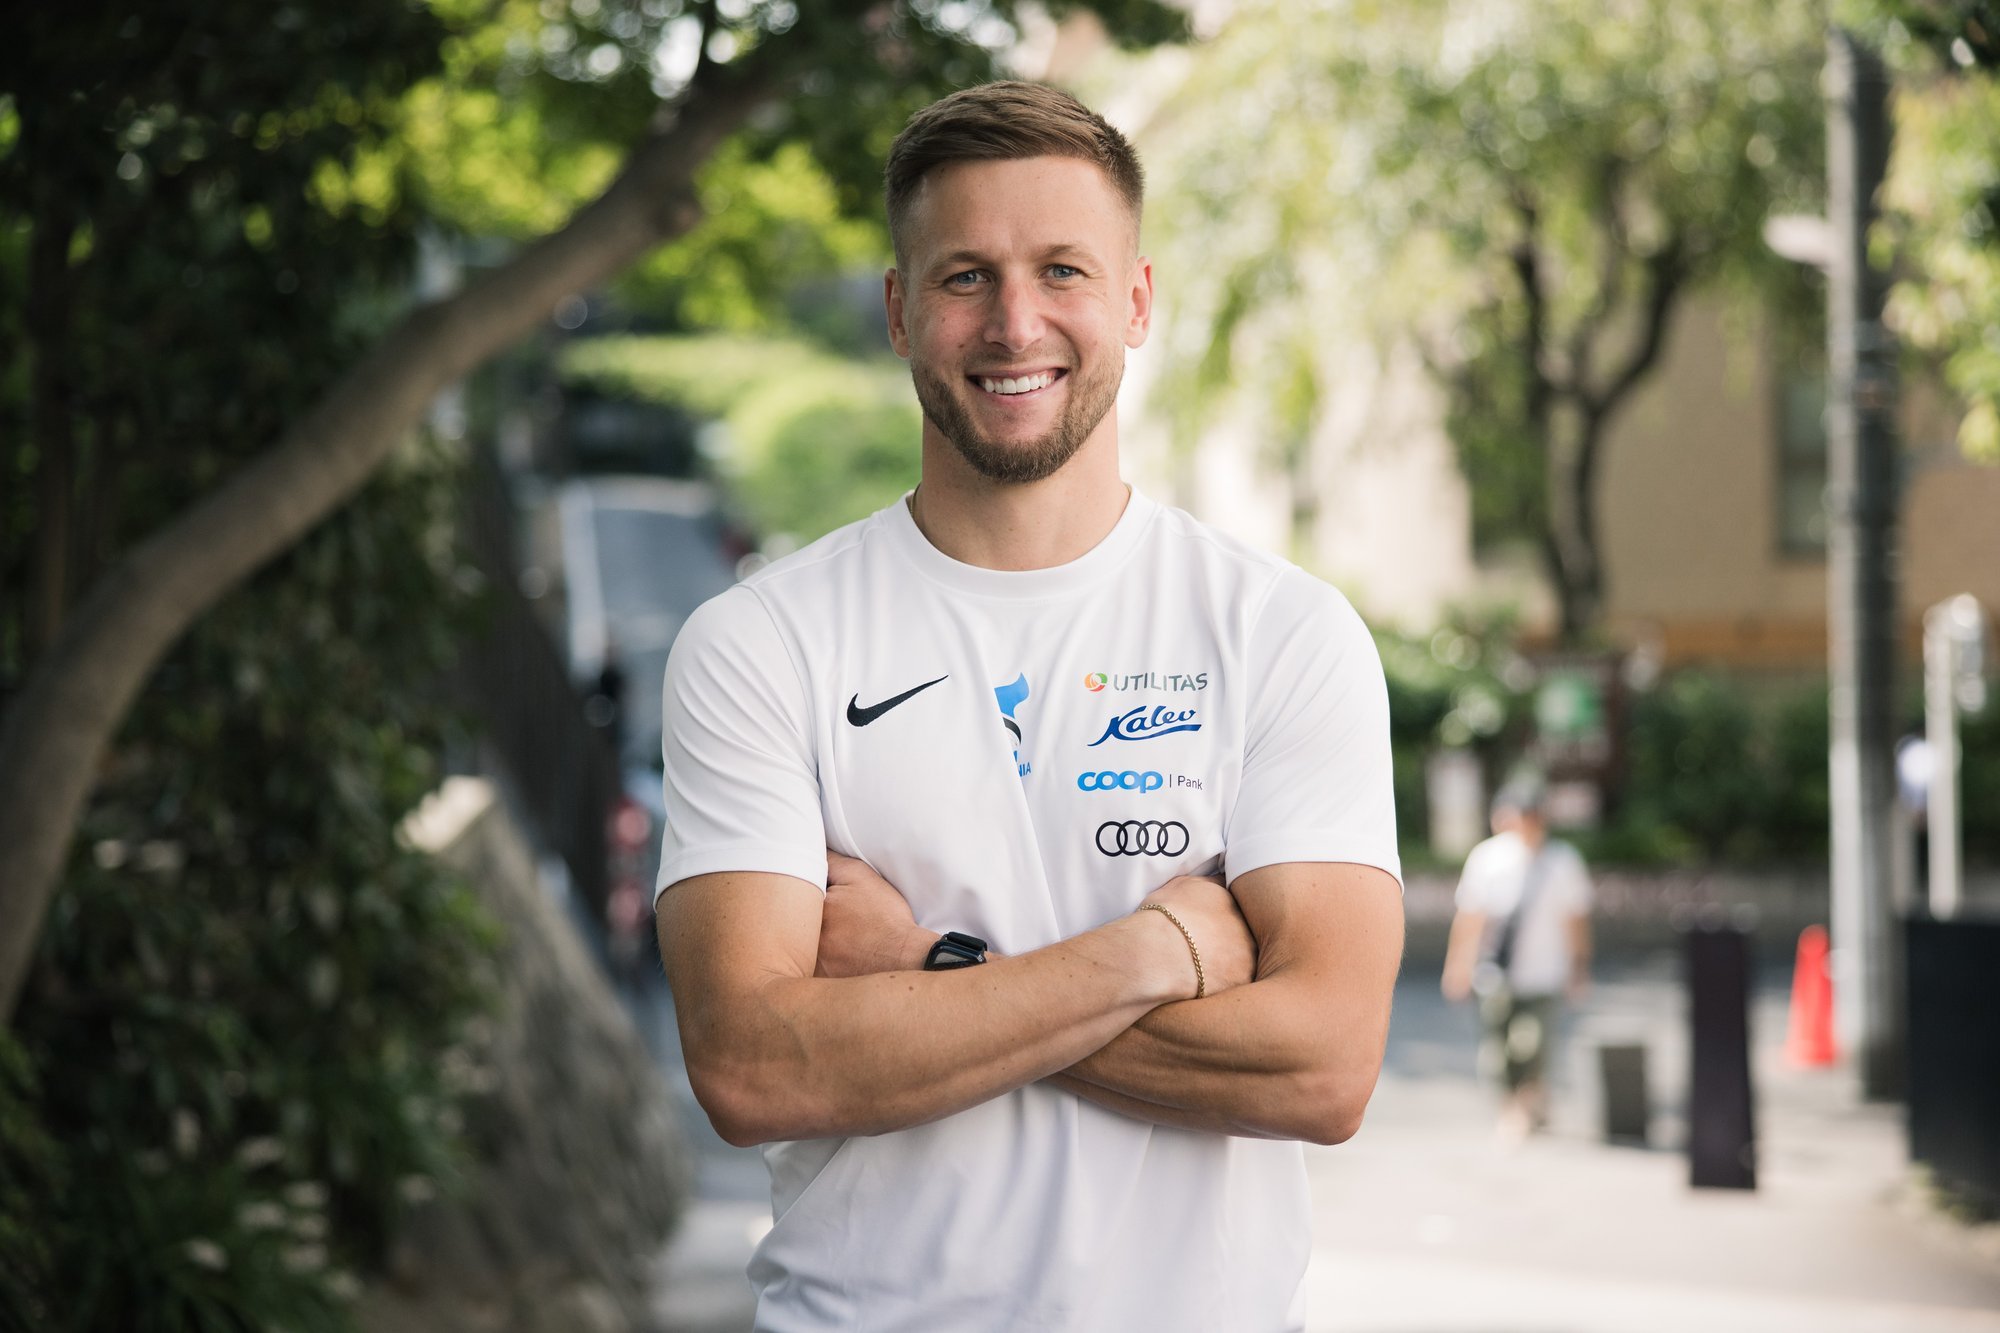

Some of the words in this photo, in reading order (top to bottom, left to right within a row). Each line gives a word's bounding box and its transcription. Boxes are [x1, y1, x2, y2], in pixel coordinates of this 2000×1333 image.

[1113, 671, 1208, 692] UTILITAS
[1086, 705, 1202, 747] Kalev
[1077, 770, 1163, 793] coop
[1177, 775, 1203, 791] Pank
